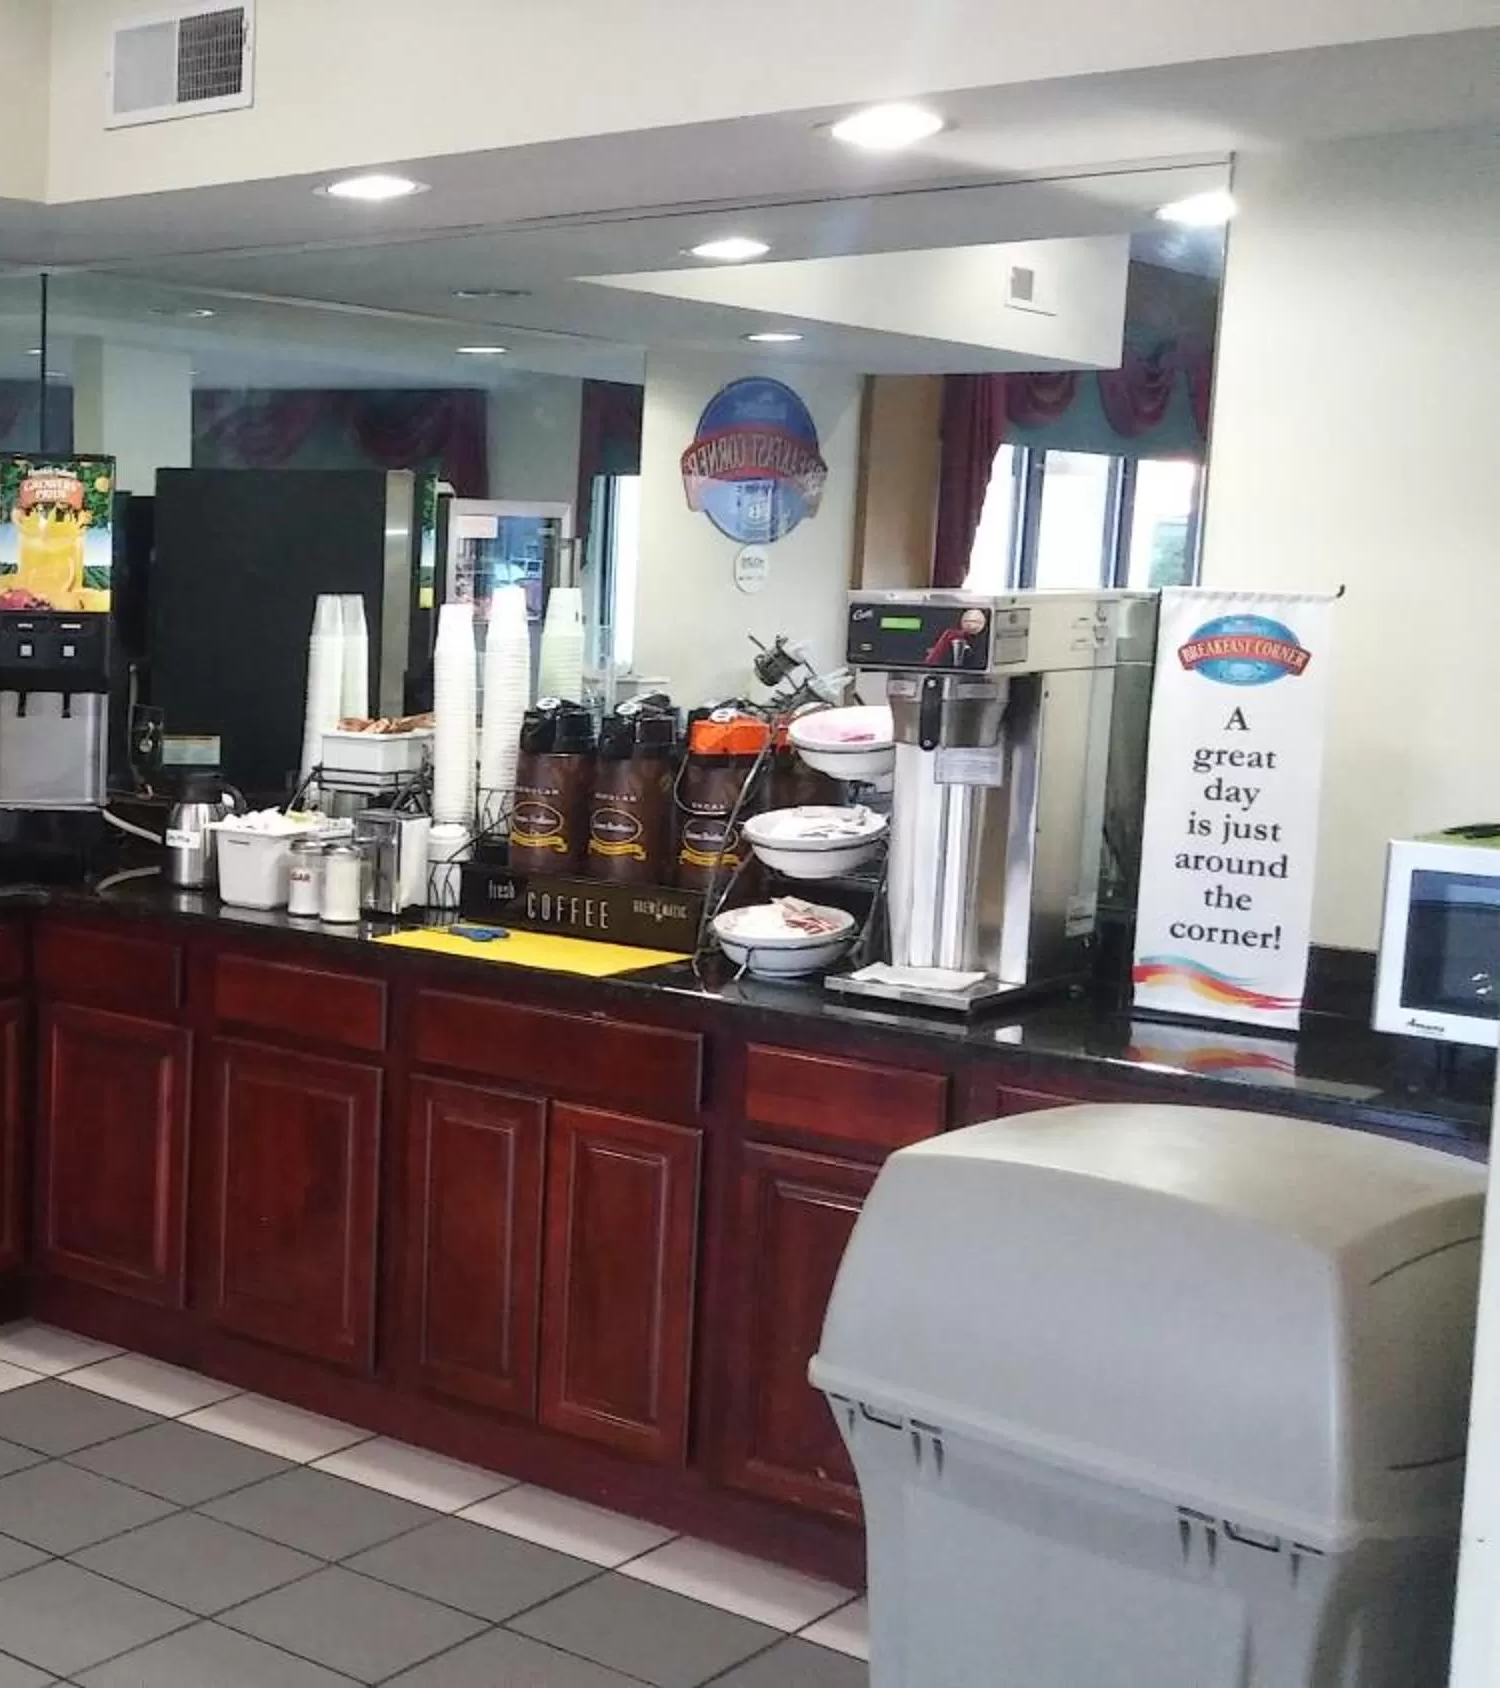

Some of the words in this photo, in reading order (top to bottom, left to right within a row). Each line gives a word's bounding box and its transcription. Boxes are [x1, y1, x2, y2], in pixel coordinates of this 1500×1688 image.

[1182, 639, 1252, 662] BREAKFAST
[1255, 640, 1307, 668] CORNER
[1224, 707, 1250, 731] A
[1192, 746, 1277, 773] great
[1203, 778, 1261, 811] day
[1187, 811, 1212, 837] is
[1222, 813, 1282, 843] just
[1175, 852, 1288, 880] around
[527, 891, 609, 929] COFFEE
[1203, 885, 1252, 912] the
[1169, 920, 1283, 951] corner!
